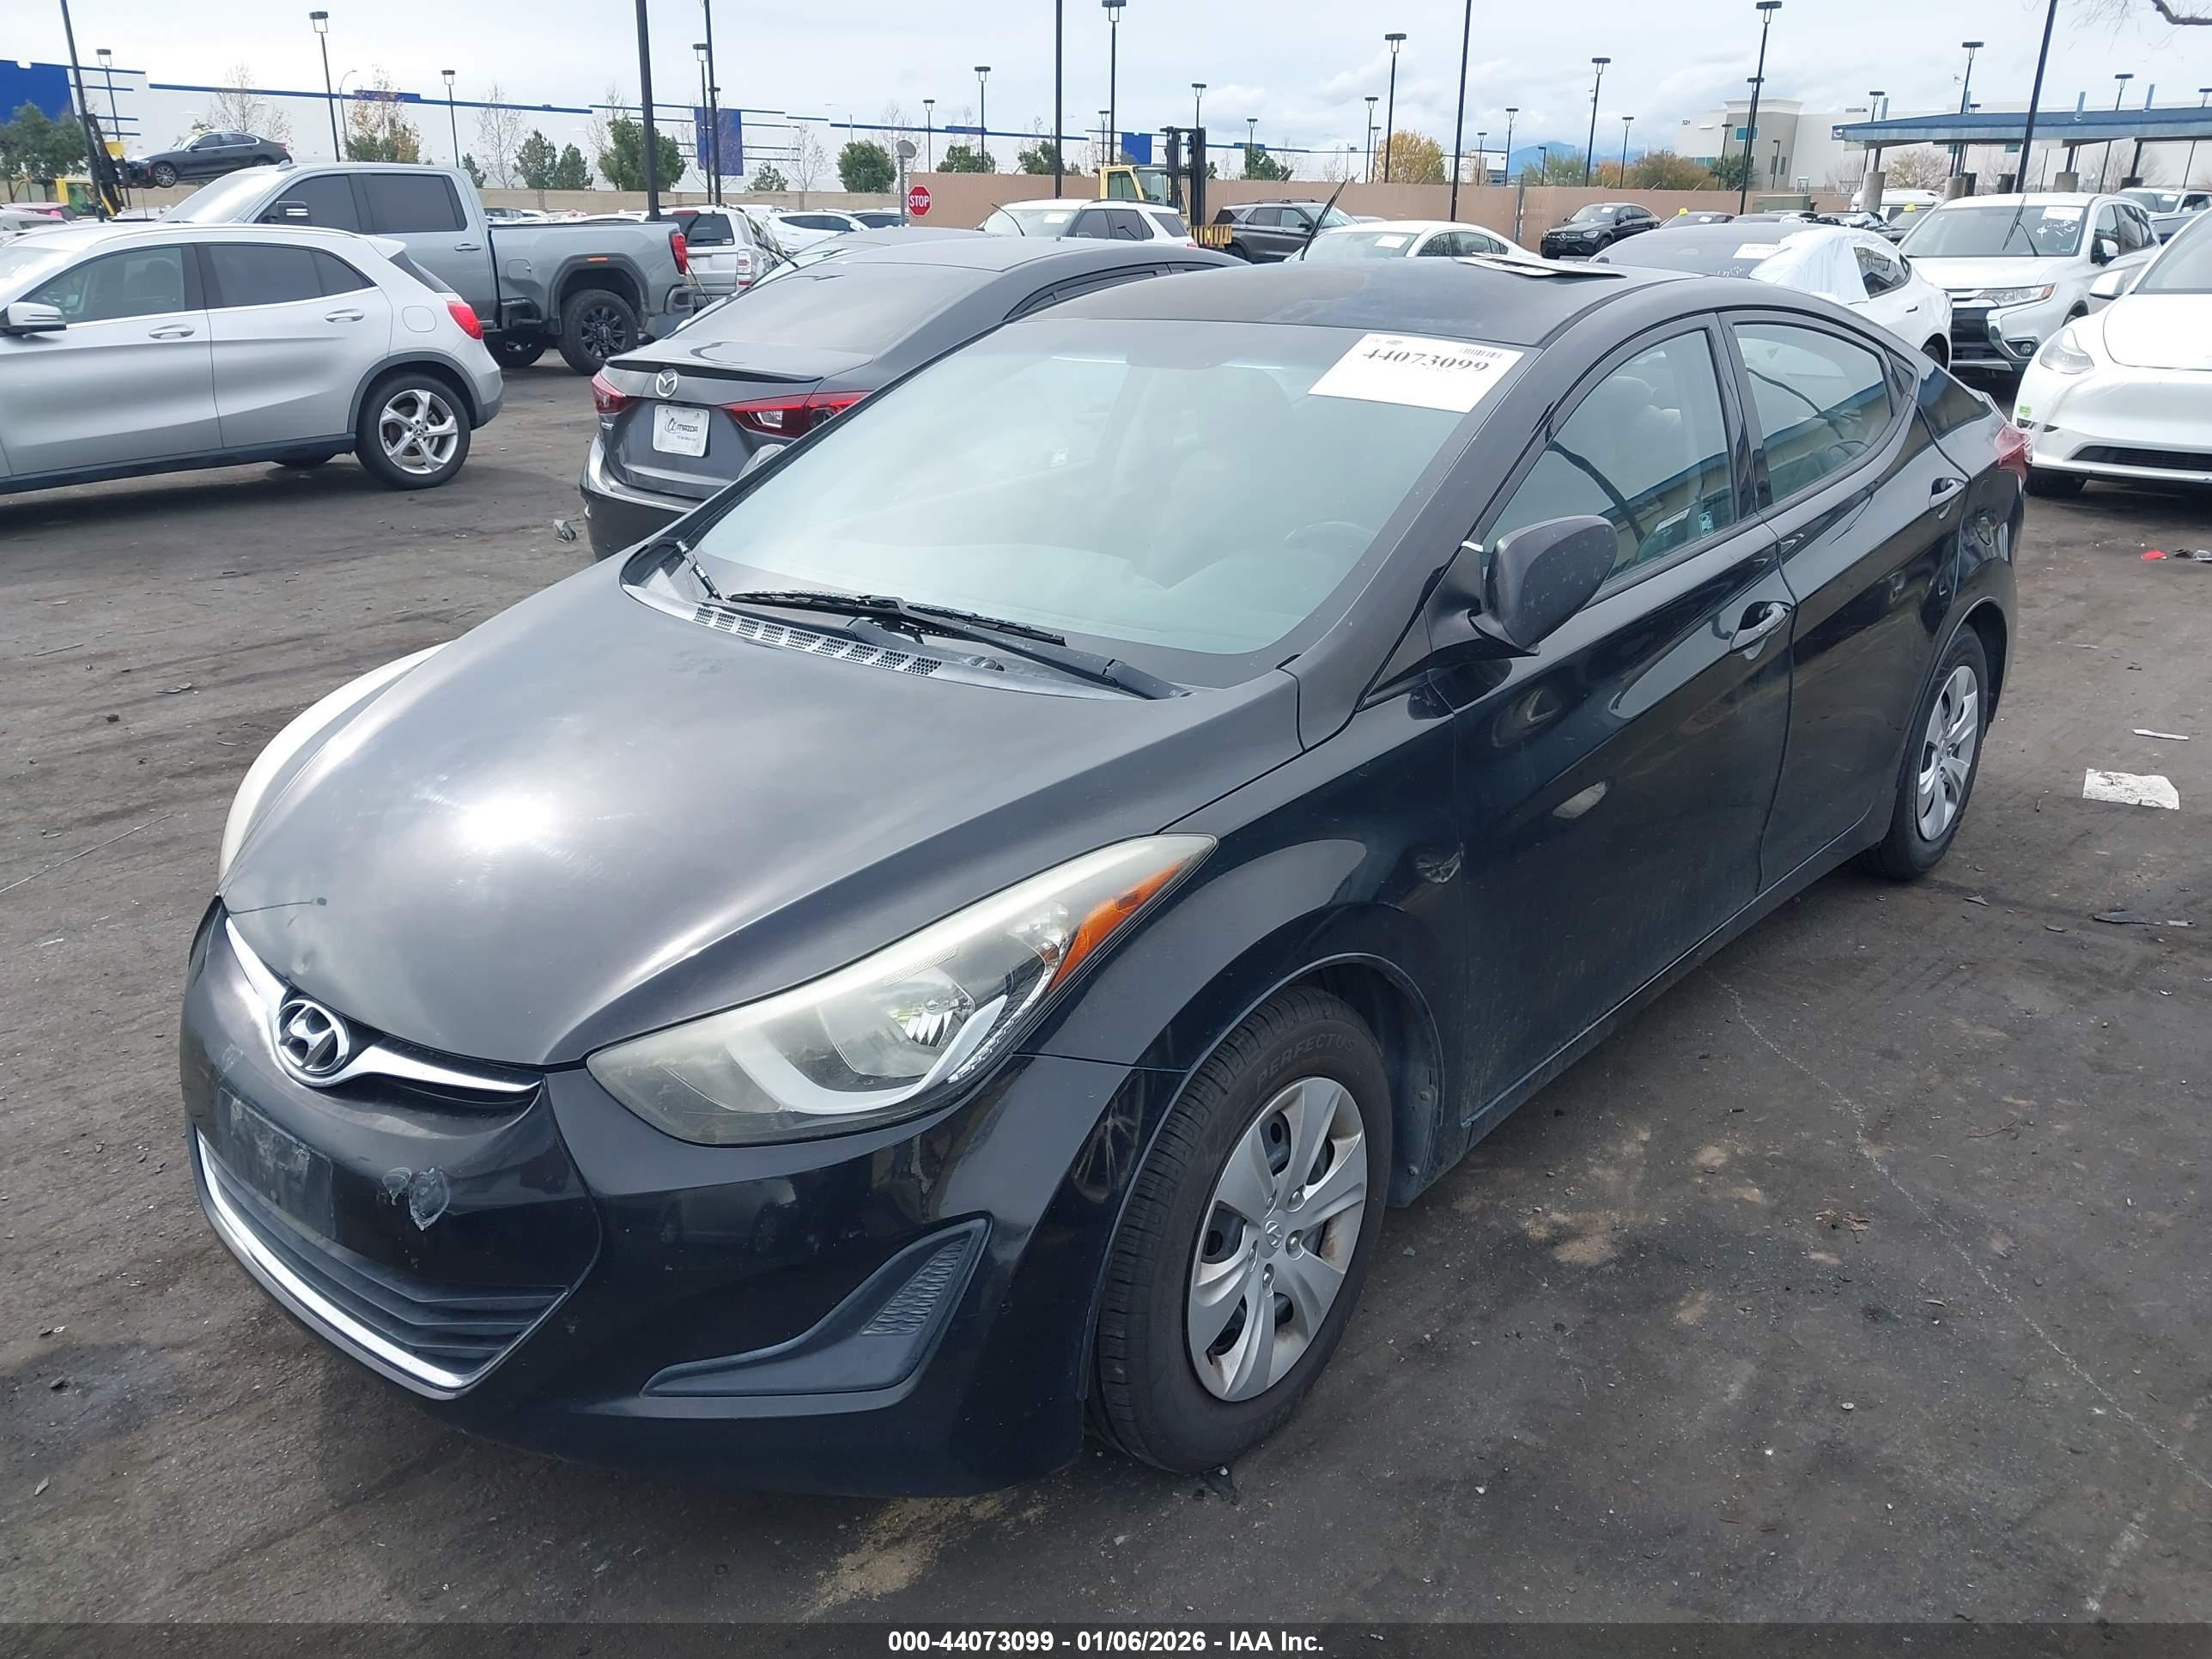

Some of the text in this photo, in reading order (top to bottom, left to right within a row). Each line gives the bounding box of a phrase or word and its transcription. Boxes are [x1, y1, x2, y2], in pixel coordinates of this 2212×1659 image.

[908, 194, 930, 207] STOP
[1362, 347, 1490, 373] 44073099
[1256, 1033, 1354, 1092] PERFECTUS
